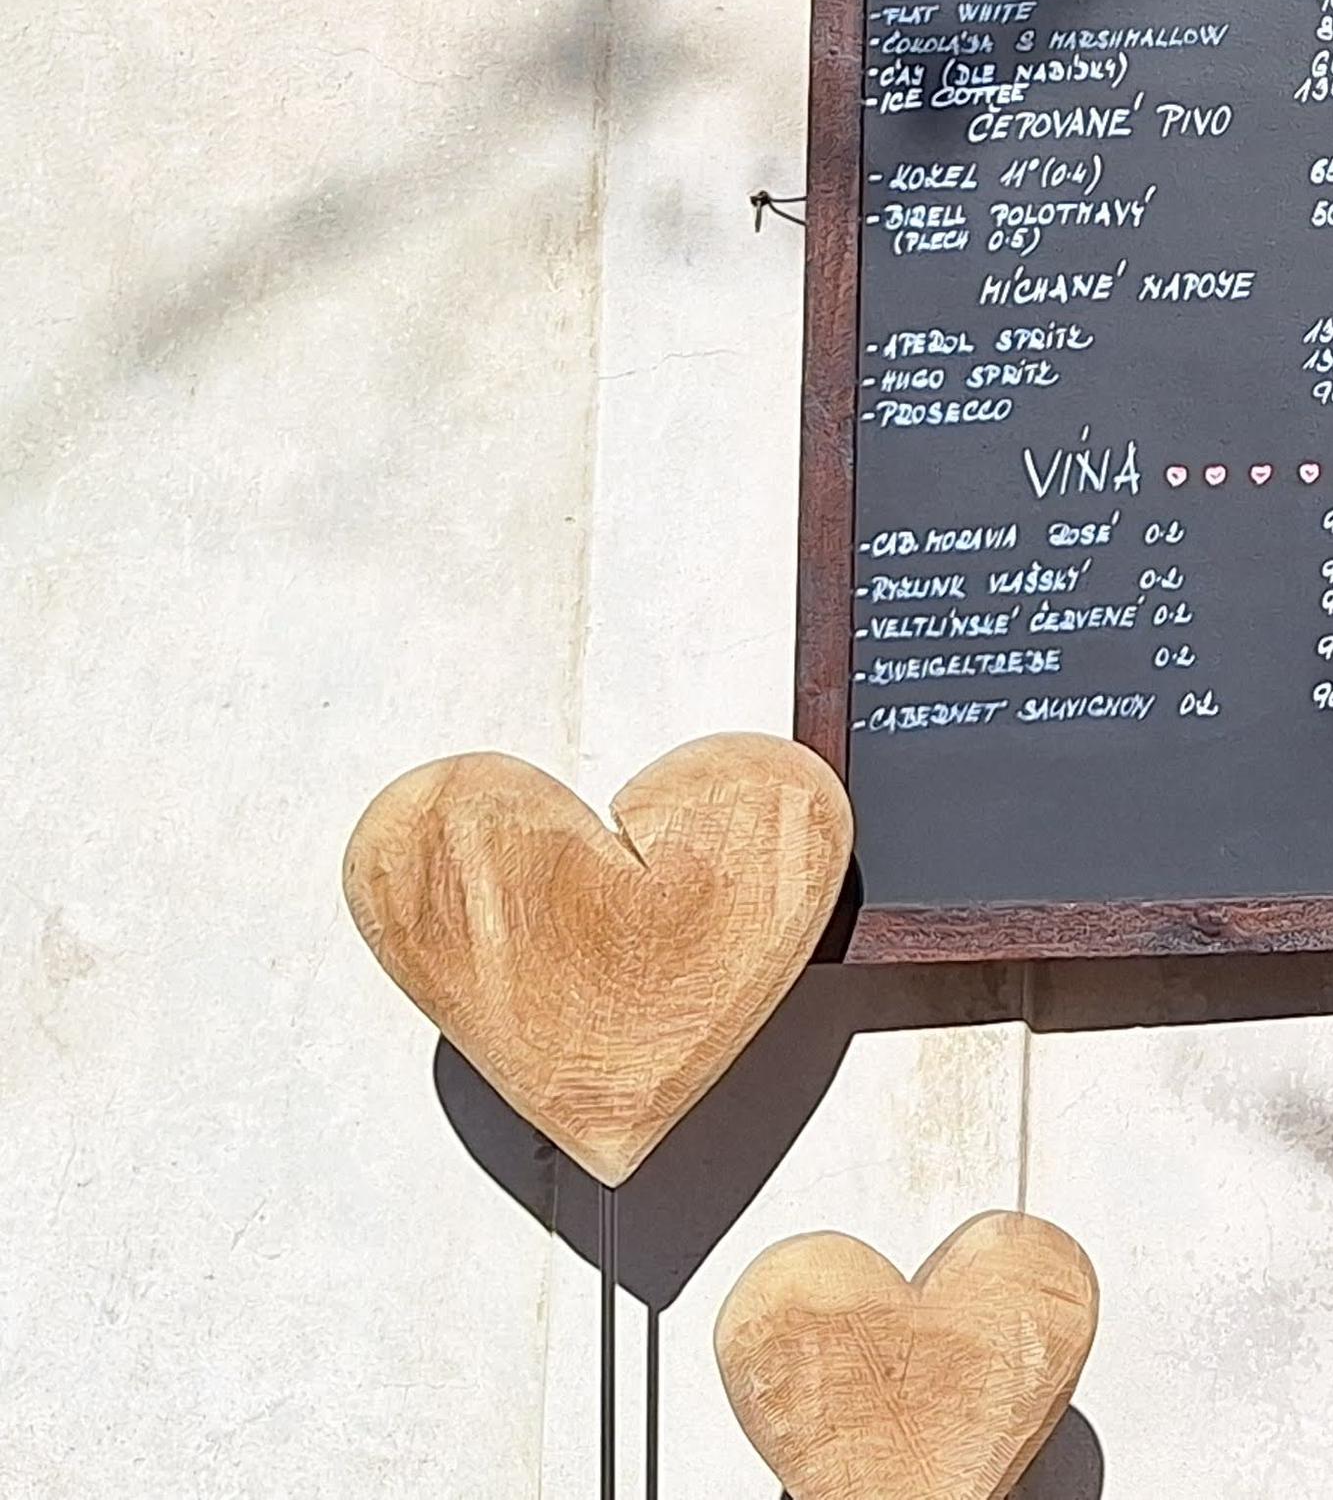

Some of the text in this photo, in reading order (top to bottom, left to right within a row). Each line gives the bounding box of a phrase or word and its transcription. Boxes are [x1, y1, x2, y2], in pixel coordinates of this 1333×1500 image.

[958, 1, 1038, 24] WHITE
[1156, 104, 1232, 138] PIVO
[1024, 425, 1141, 498] VÍNA
